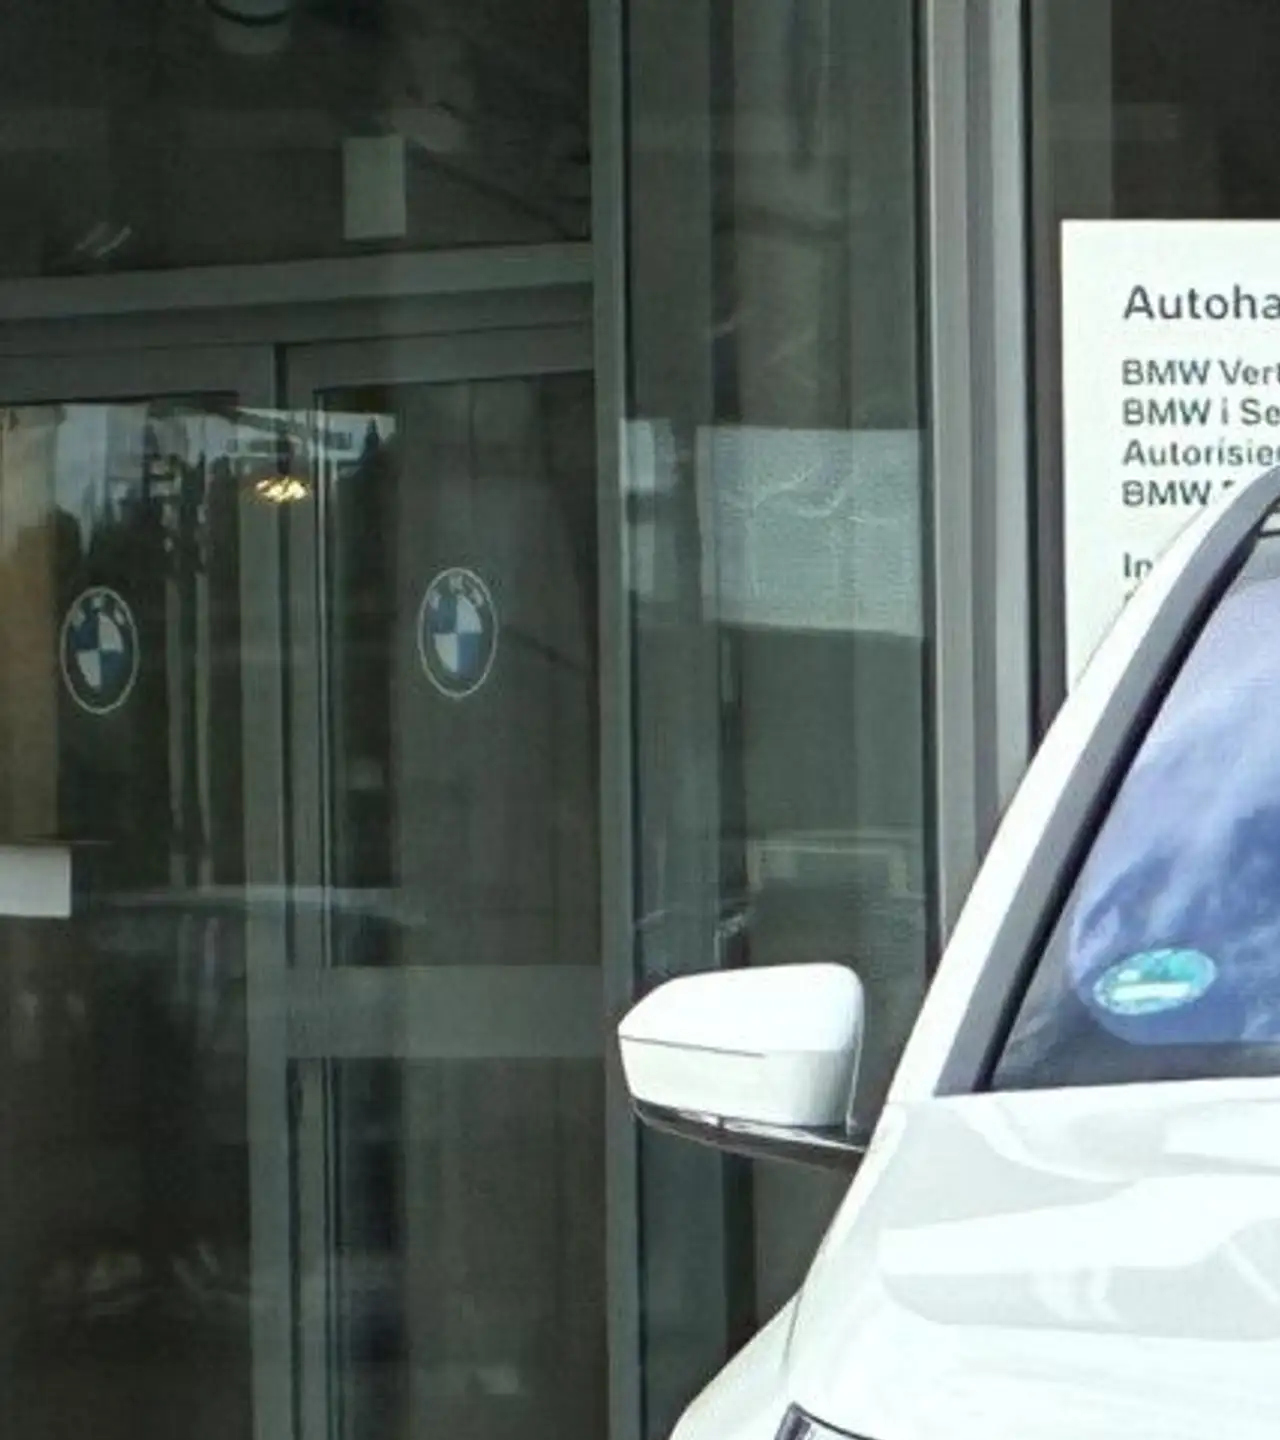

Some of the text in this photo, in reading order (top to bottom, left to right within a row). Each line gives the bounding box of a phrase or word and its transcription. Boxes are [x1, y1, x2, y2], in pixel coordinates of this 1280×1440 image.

[1122, 359, 1211, 386] BMW
[1122, 398, 1212, 426] BMW
[1220, 397, 1230, 426] i
[1122, 480, 1212, 507] BMW
